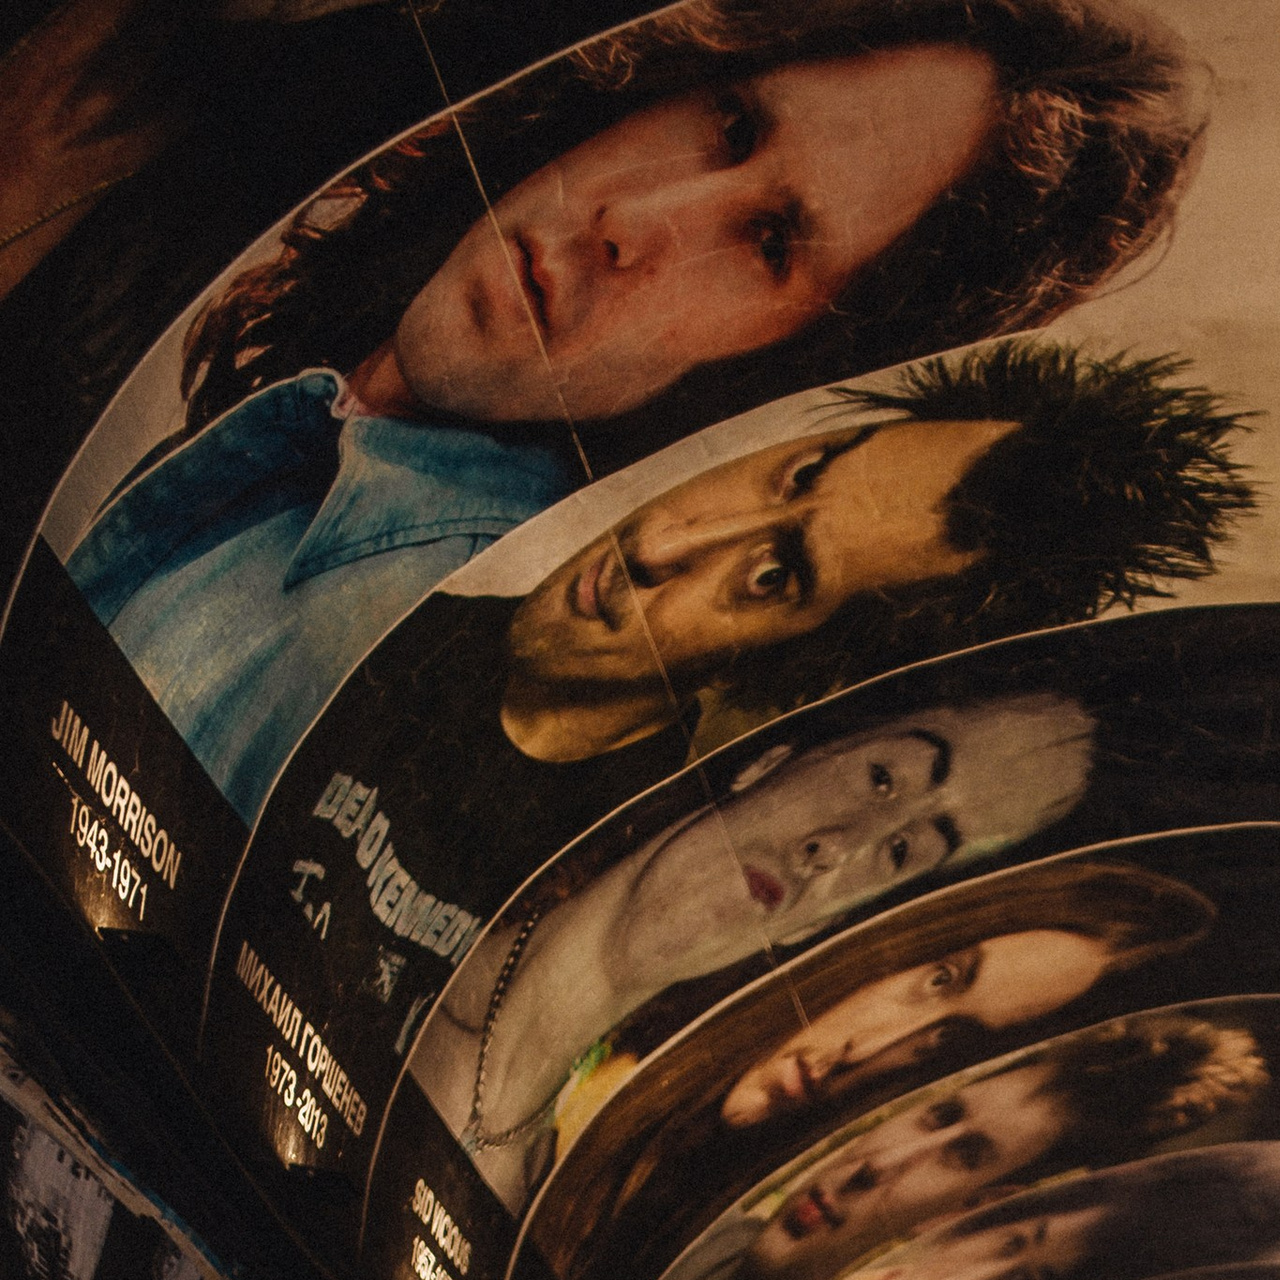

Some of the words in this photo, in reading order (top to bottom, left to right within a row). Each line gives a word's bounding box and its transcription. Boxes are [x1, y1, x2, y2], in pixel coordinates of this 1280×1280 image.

[52, 700, 90, 769] JIM
[86, 739, 182, 890] MORRISON
[70, 795, 148, 922] 1943-1971
[235, 940, 304, 1049] МИХАИЛ
[299, 1021, 368, 1138] ГОРШЕНЕВ
[265, 1043, 329, 1150] 1973-2013
[412, 1178, 435, 1225] SID
